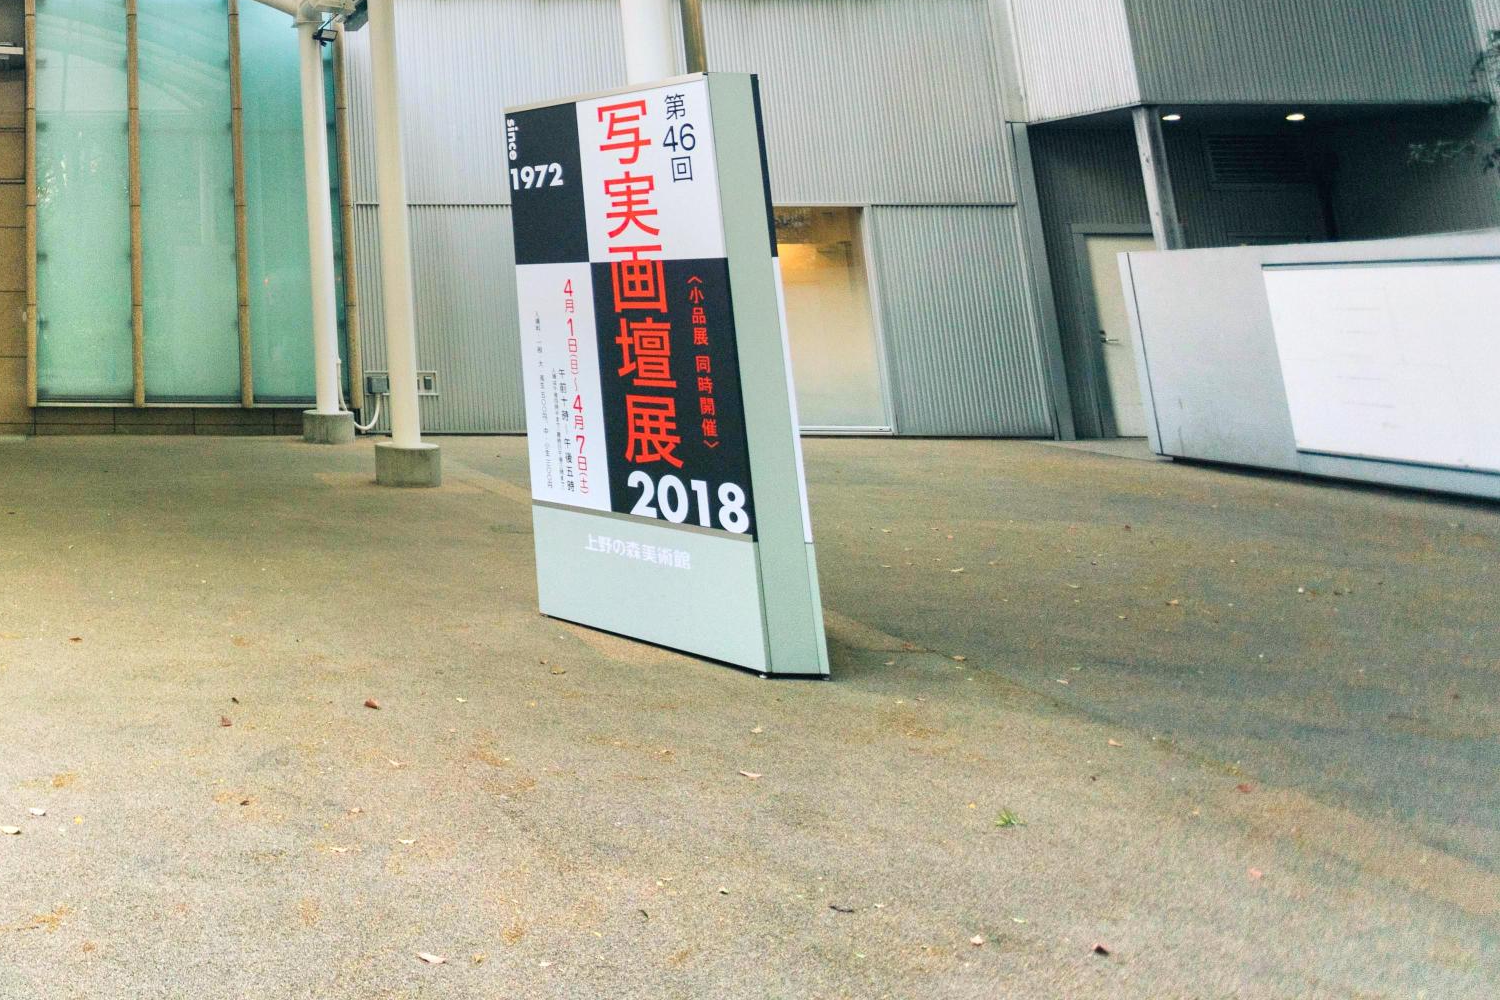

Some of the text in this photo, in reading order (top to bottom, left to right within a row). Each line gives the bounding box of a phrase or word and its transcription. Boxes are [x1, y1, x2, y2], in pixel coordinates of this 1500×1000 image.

[506, 118, 519, 161] since
[661, 94, 697, 183] 第46回
[510, 162, 564, 191] 1972
[597, 99, 684, 469] 写実画壇展
[627, 470, 750, 534] 2018
[585, 533, 692, 570] 上野の森美術館
